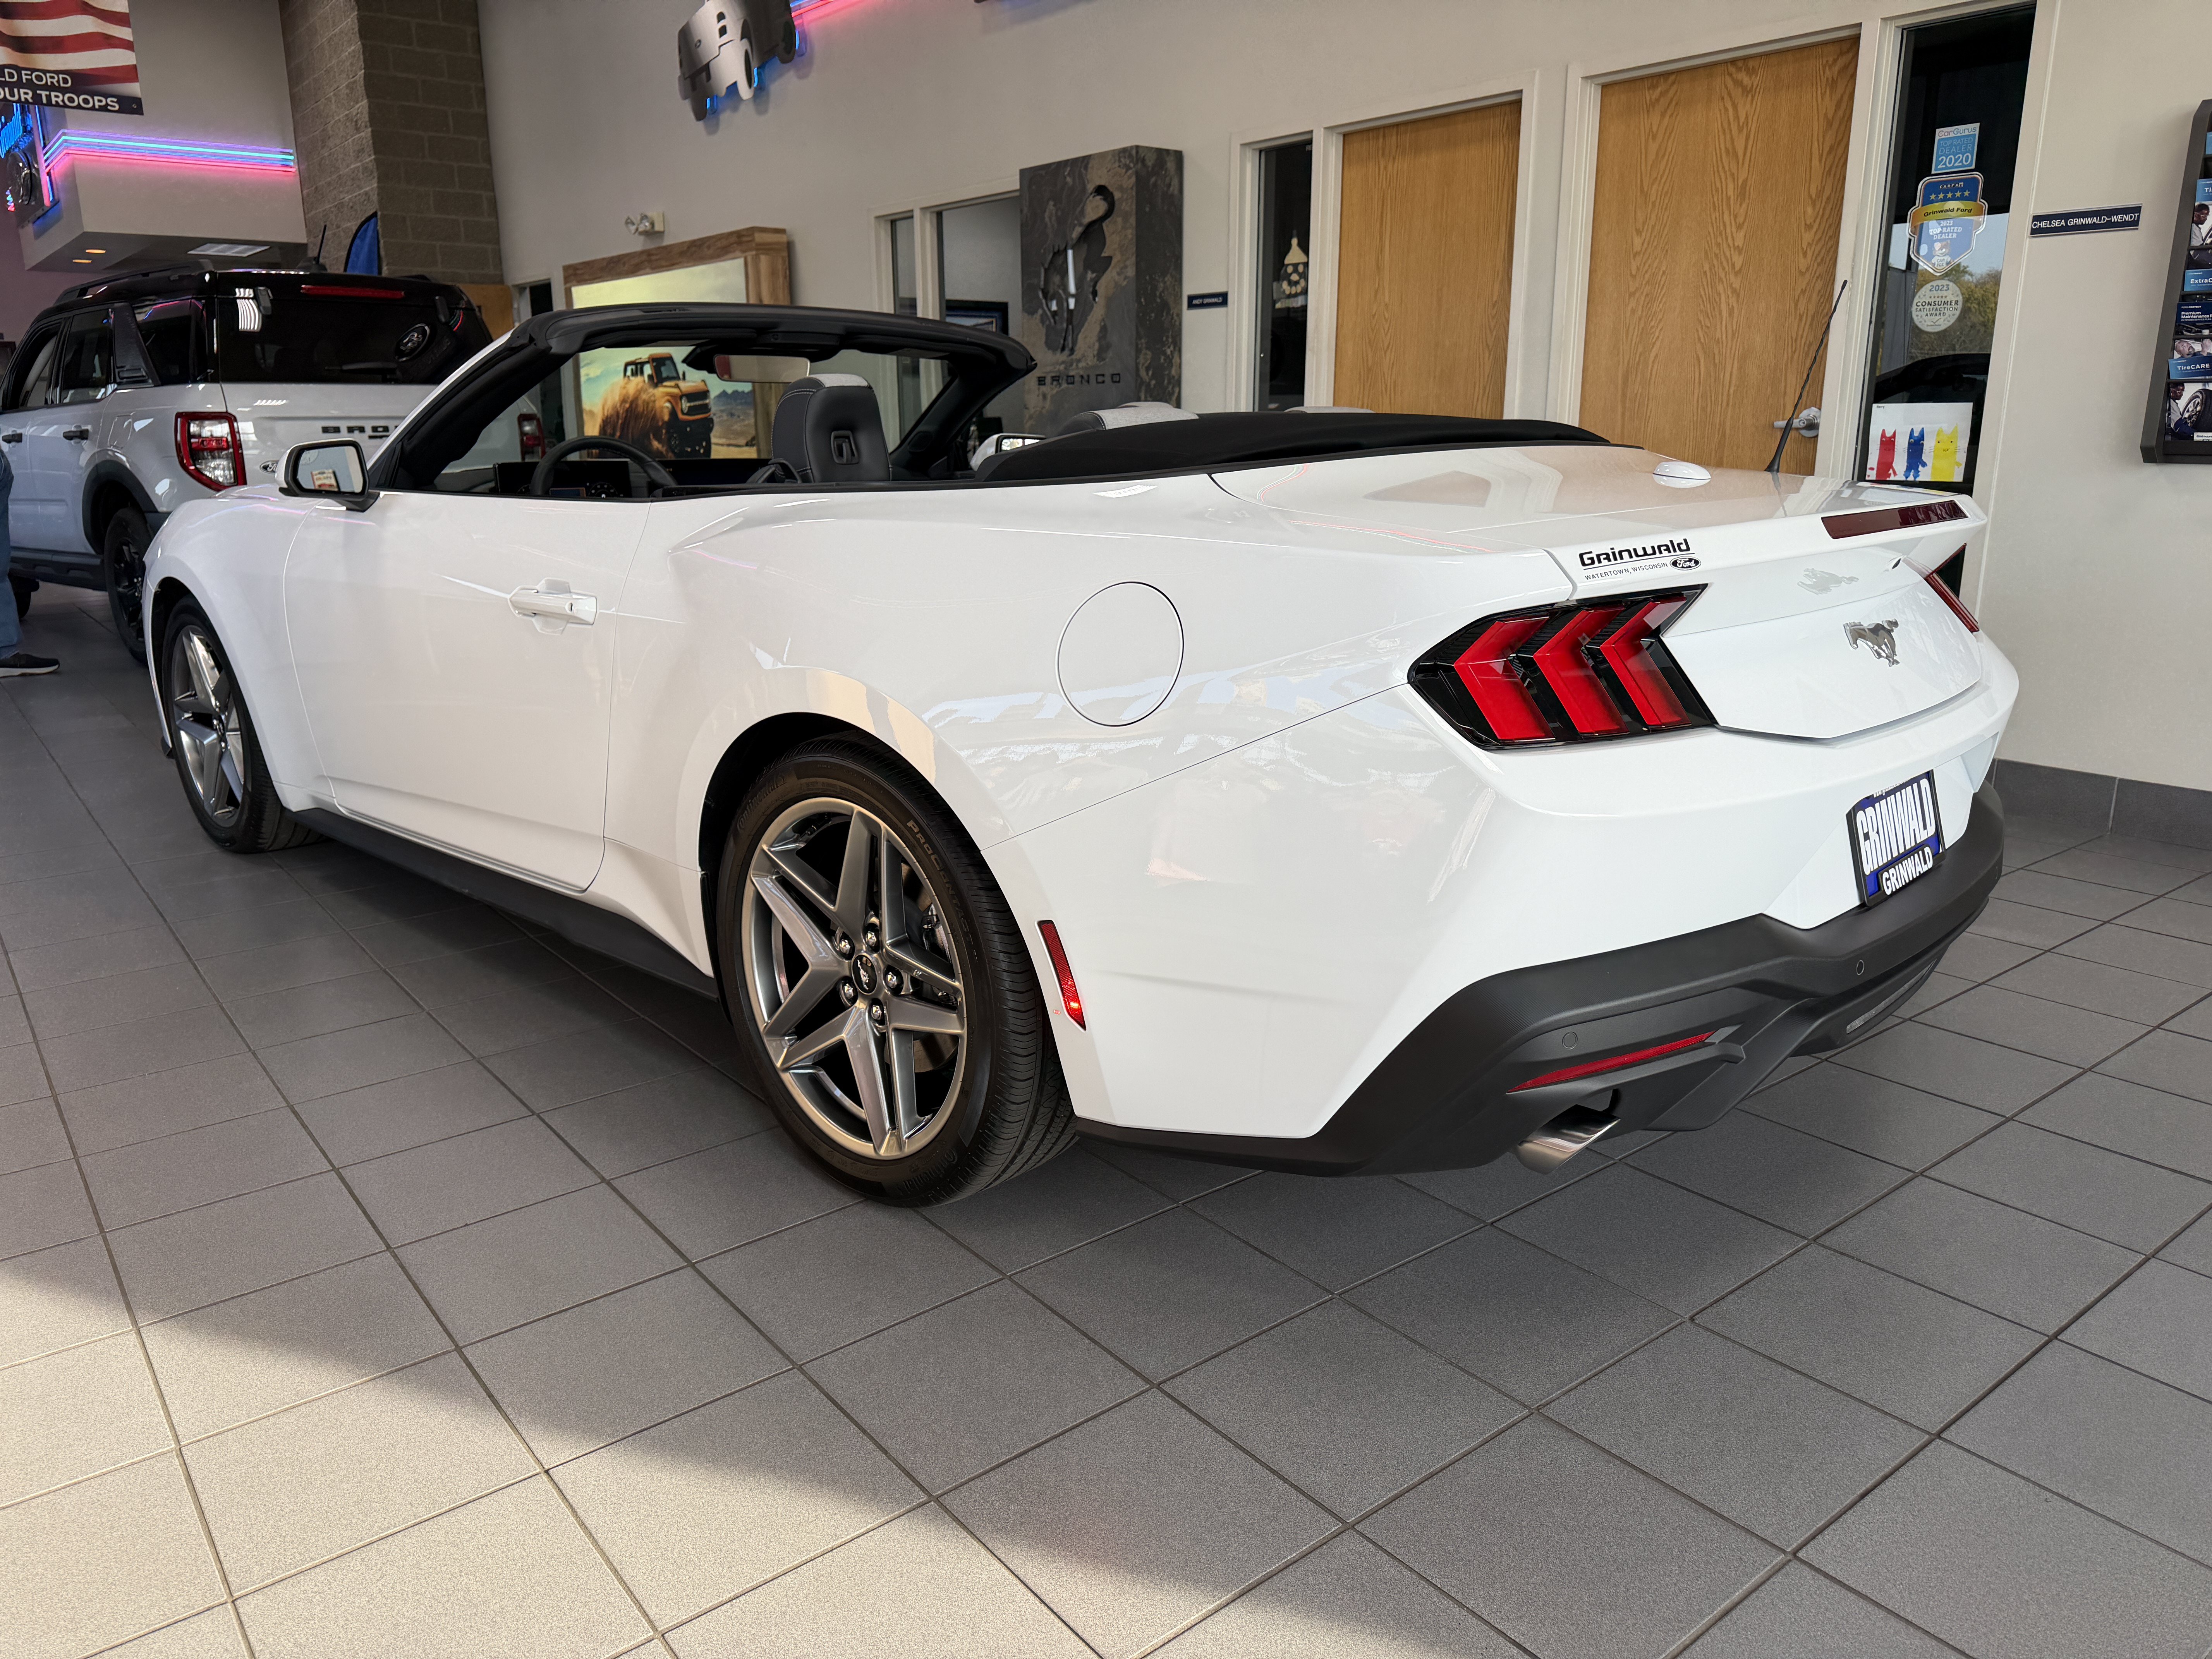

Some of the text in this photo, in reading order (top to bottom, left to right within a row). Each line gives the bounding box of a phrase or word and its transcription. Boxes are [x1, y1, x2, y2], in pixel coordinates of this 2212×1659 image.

[21, 70, 72, 88] FORD
[37, 90, 120, 111] TROOPS
[1938, 127, 1977, 137] CarGurus
[1953, 137, 1973, 145] RATED
[1939, 144, 1972, 155] DEALER
[1937, 153, 1972, 168] 2020
[1923, 207, 1973, 217] Grinwald Ford
[2032, 213, 2140, 229] CHELSEA GRINWALD-WENDT
[1929, 284, 1950, 292] 2023
[1037, 373, 1120, 387] BRONCO
[321, 425, 398, 433] BRO
[1585, 568, 1632, 580] WATERTOWN,
[1632, 562, 1668, 572] WISCONSIN
[1856, 778, 1936, 875] GRINWALD
[1882, 846, 1933, 895] GRINWALD
